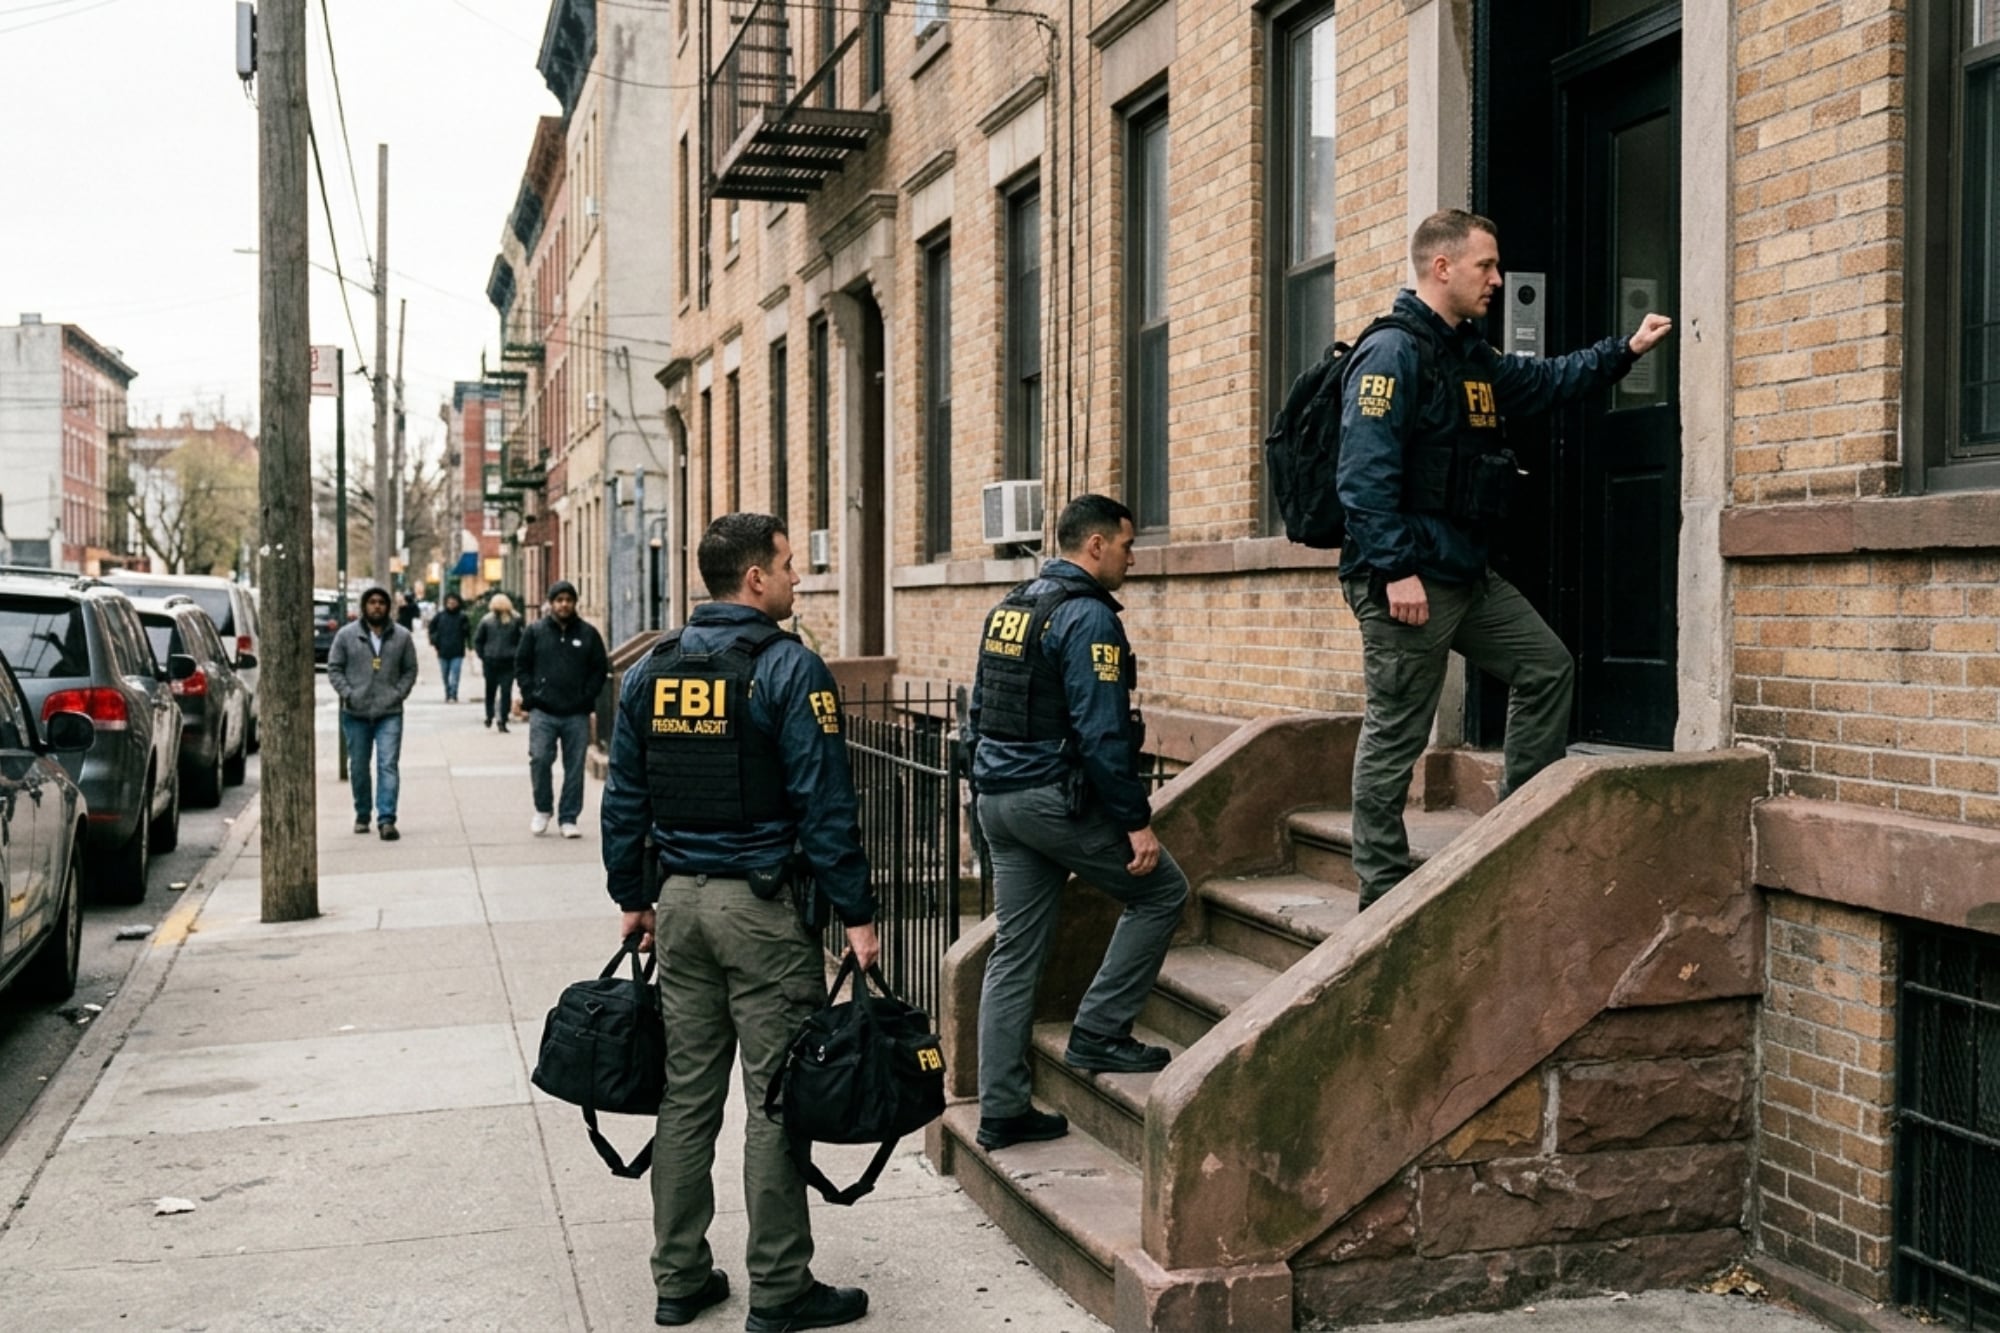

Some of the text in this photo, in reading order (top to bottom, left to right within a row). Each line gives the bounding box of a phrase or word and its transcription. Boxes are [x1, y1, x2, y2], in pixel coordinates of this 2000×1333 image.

[1360, 375, 1395, 399] FBI
[988, 610, 1030, 642] FBI
[654, 678, 726, 717] FBI
[809, 691, 836, 716] FB
